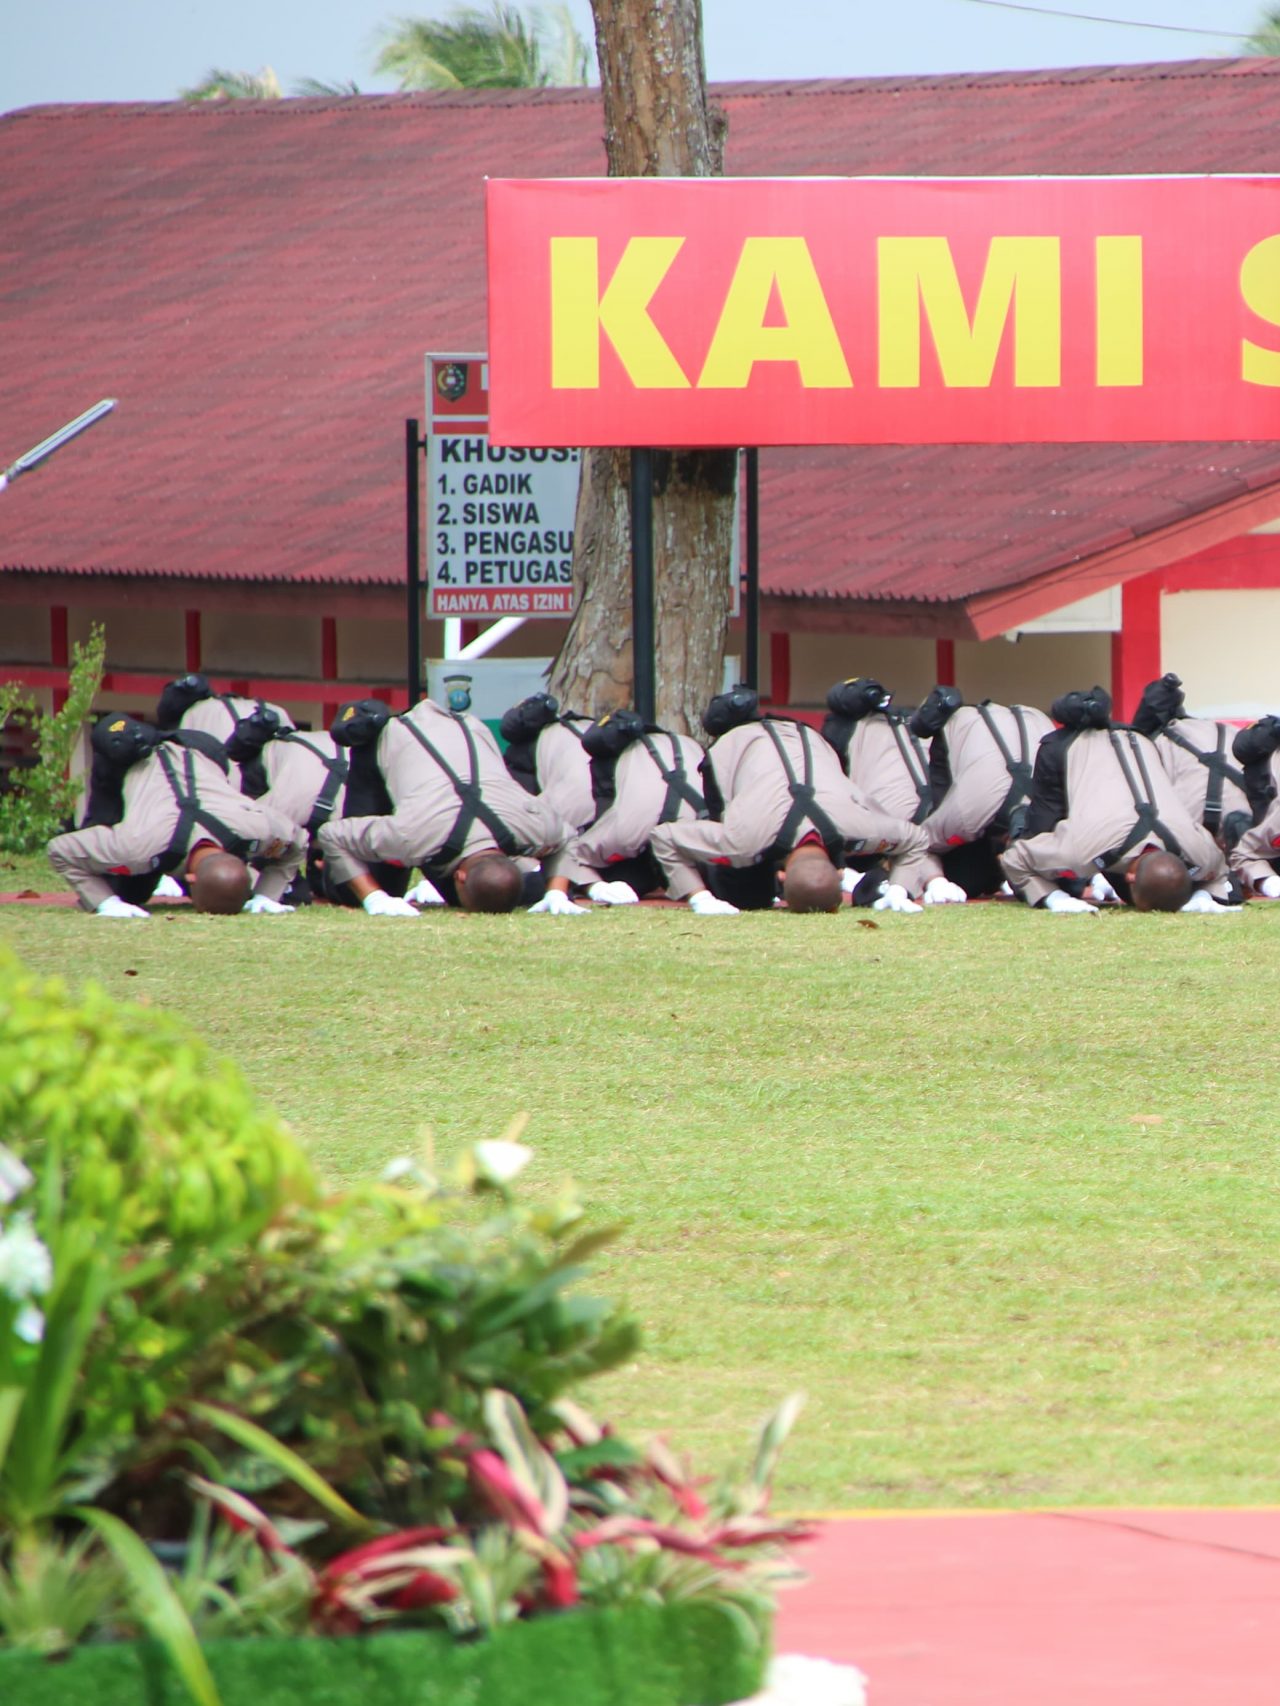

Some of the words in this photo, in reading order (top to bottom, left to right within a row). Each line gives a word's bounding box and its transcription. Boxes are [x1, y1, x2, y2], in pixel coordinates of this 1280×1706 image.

[549, 234, 1144, 390] KAMI
[437, 473, 456, 495] 1.
[463, 473, 533, 495] GADIK
[437, 503, 458, 525] 2.
[462, 502, 540, 525] SISWA
[436, 531, 456, 555] 3.
[437, 561, 457, 584] 4.
[465, 560, 573, 583] PETUGAS
[437, 595, 489, 611] HANYA
[492, 594, 530, 611] ATAS
[533, 592, 564, 610] IZIN
